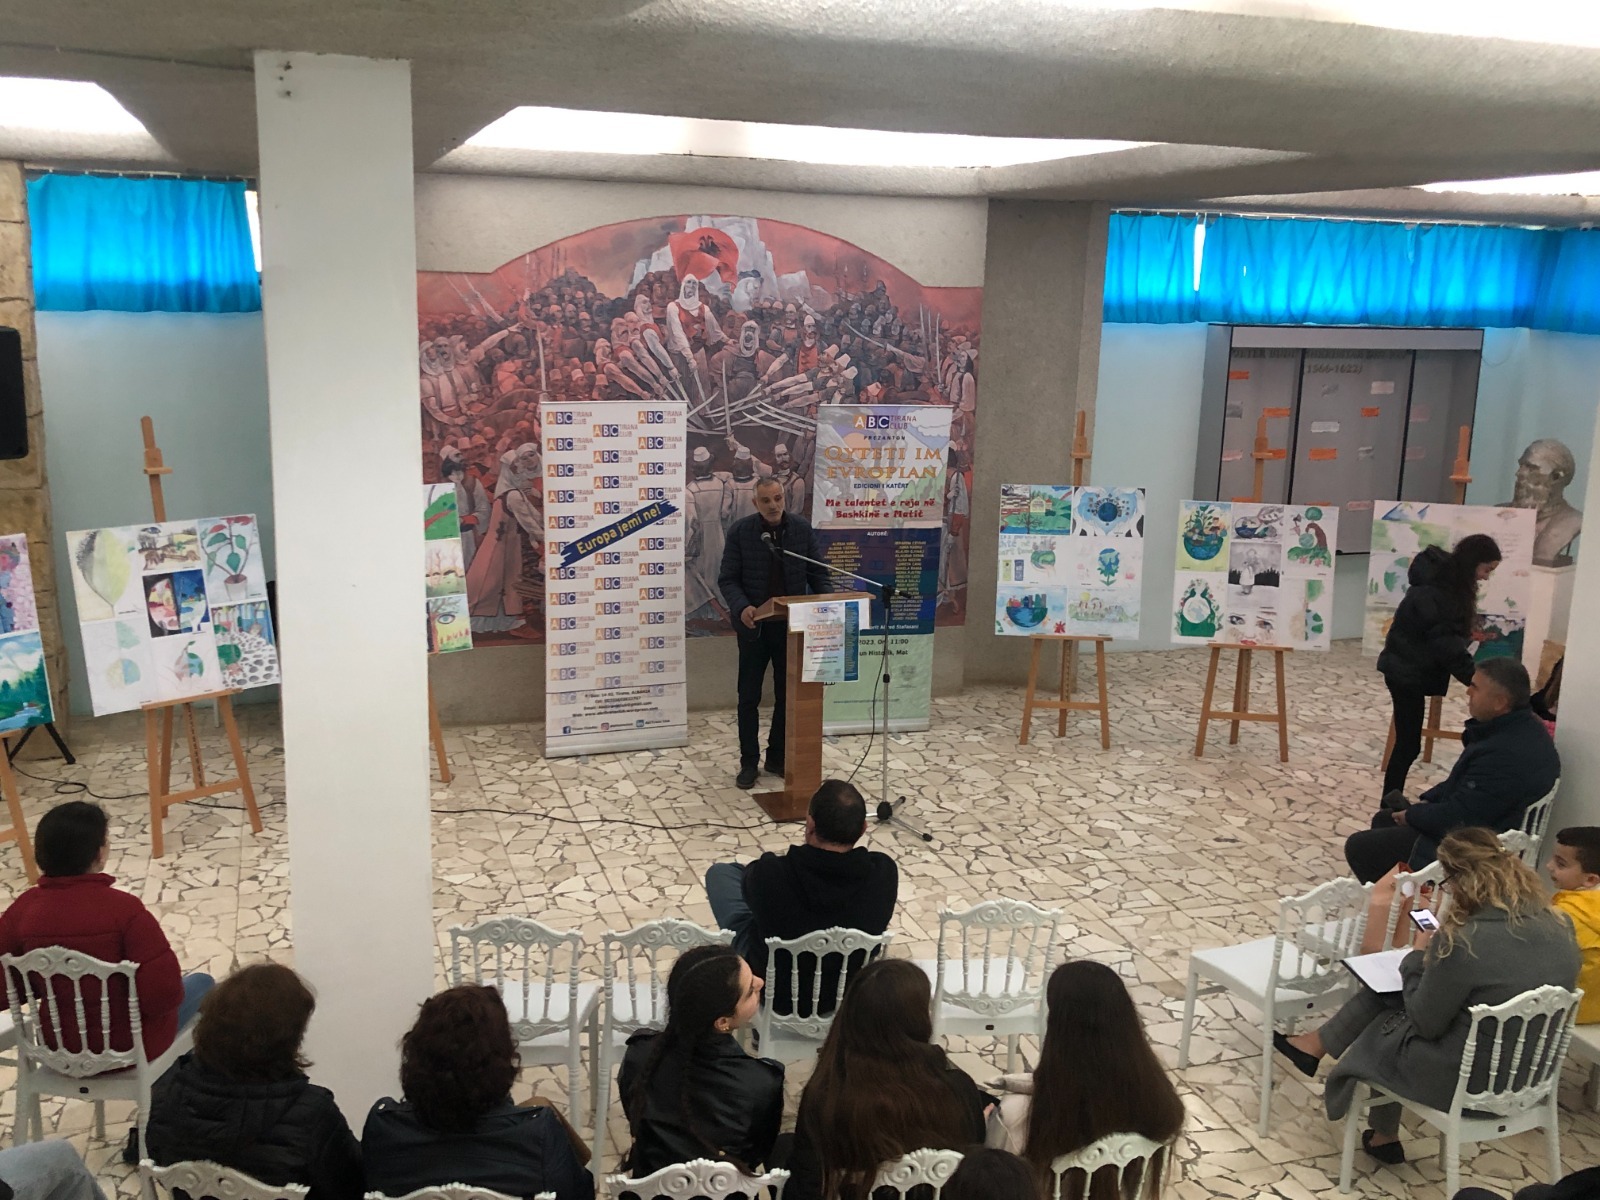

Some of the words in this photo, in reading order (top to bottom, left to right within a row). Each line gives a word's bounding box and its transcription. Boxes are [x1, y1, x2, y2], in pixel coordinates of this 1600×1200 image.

[547, 412, 573, 424] ABC
[638, 411, 664, 424] ABC
[854, 415, 890, 429] ABC
[593, 424, 619, 437] ABC
[547, 438, 574, 451] ABC
[638, 437, 664, 450] ABC
[593, 450, 619, 463] ABC
[824, 445, 906, 463] QYTETI
[916, 447, 942, 460] IM
[548, 464, 574, 477] ABC
[639, 462, 664, 475] ABC
[827, 467, 937, 479] EVROPIAN
[594, 476, 620, 489] ABC
[548, 490, 575, 503] ABC
[639, 488, 664, 500] ABC
[594, 502, 620, 514] ABC
[825, 499, 841, 507] Me
[845, 499, 887, 507] talentet
[899, 500, 920, 508] reja
[923, 498, 935, 506] në
[835, 510, 880, 519] Bashkinë
[549, 516, 575, 528] ABC
[575, 530, 617, 554] Europa
[616, 515, 642, 536] jemi
[644, 503, 661, 518] ne!
[639, 538, 664, 550] ABC
[595, 552, 620, 565] ABC
[550, 567, 575, 579] ABC
[639, 563, 664, 575] ABC
[595, 577, 621, 590] ABC
[550, 592, 576, 605] ABC
[639, 587, 664, 600] ABC
[595, 602, 621, 615] ABC
[550, 617, 576, 630] ABC
[639, 612, 664, 625] ABC
[596, 627, 621, 640] ABC
[551, 642, 576, 656] ABC
[640, 636, 664, 649] ABC
[596, 652, 621, 665] ABC
